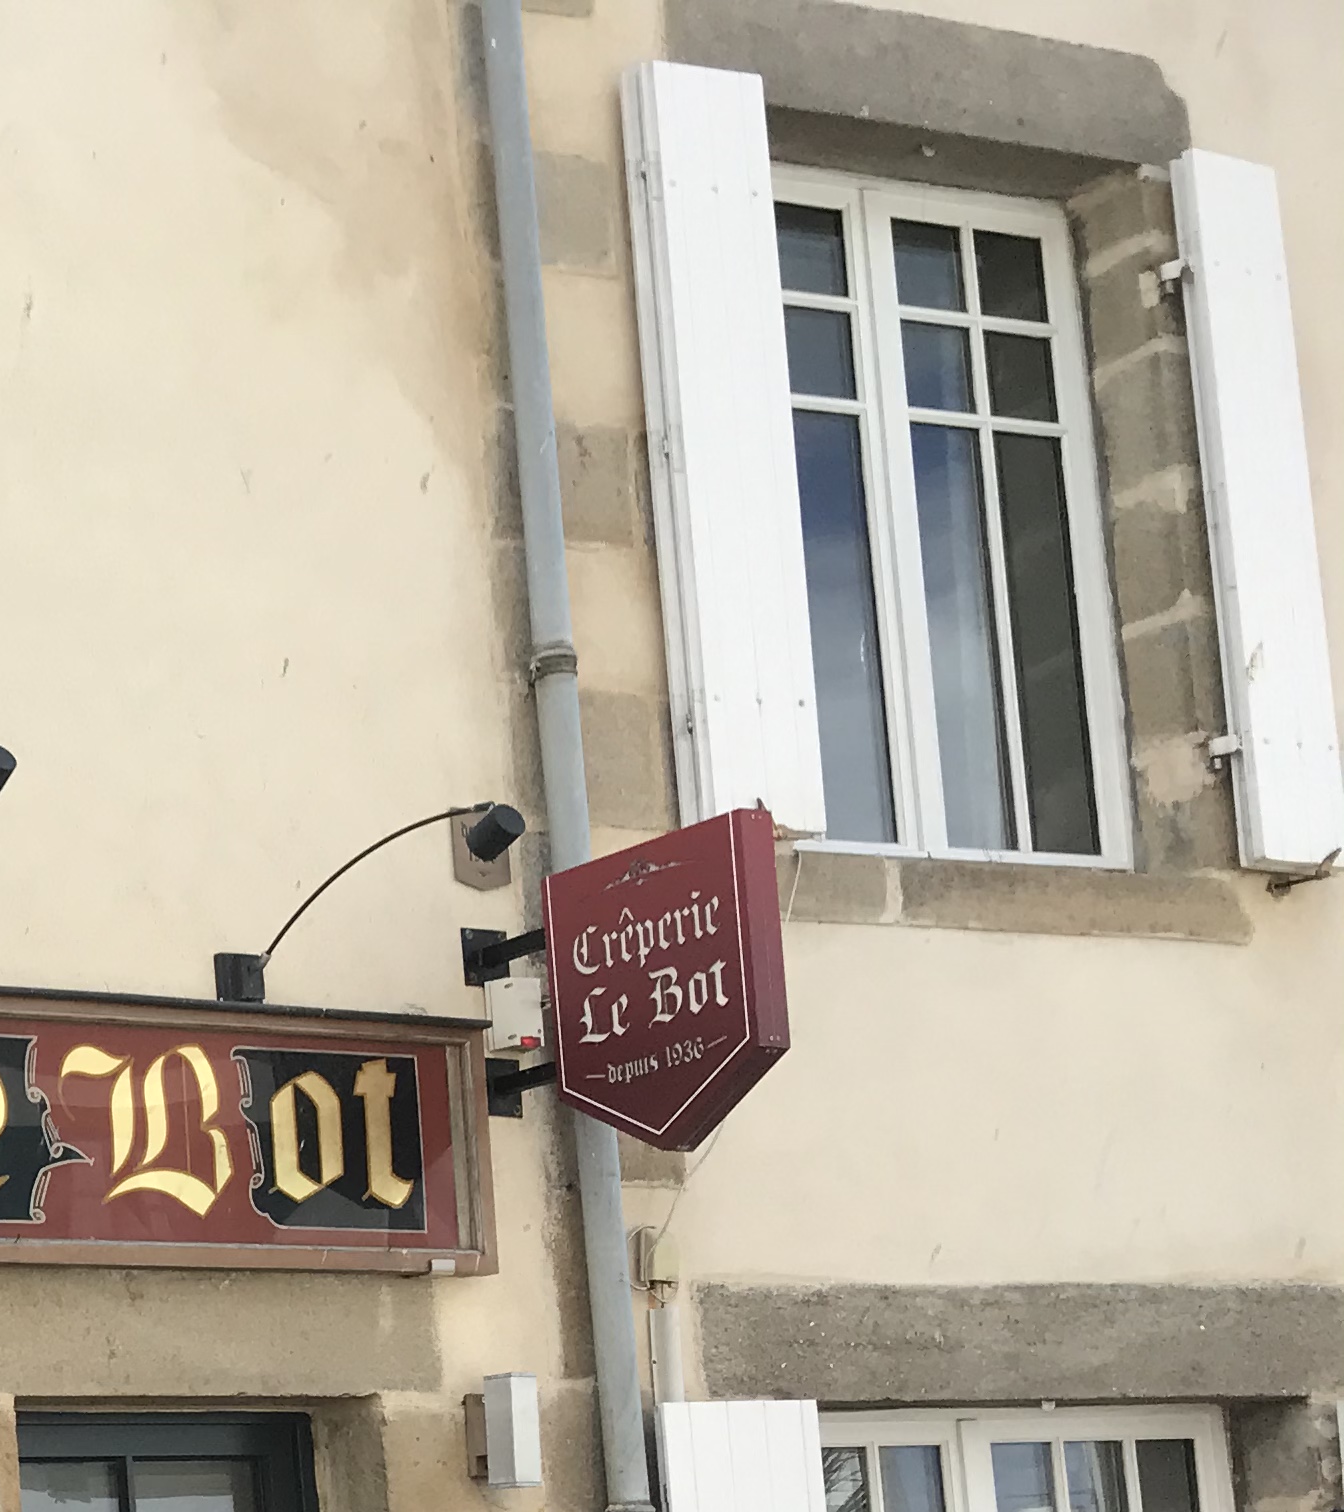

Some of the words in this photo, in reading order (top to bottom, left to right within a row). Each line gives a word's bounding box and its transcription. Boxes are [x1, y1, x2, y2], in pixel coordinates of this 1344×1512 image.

[573, 891, 720, 975] Crêperie
[578, 987, 630, 1044] Le
[648, 959, 730, 1029] Bot
[607, 1054, 659, 1083] depuis
[666, 1036, 704, 1069] 1936
[59, 1043, 417, 1217] Bot
